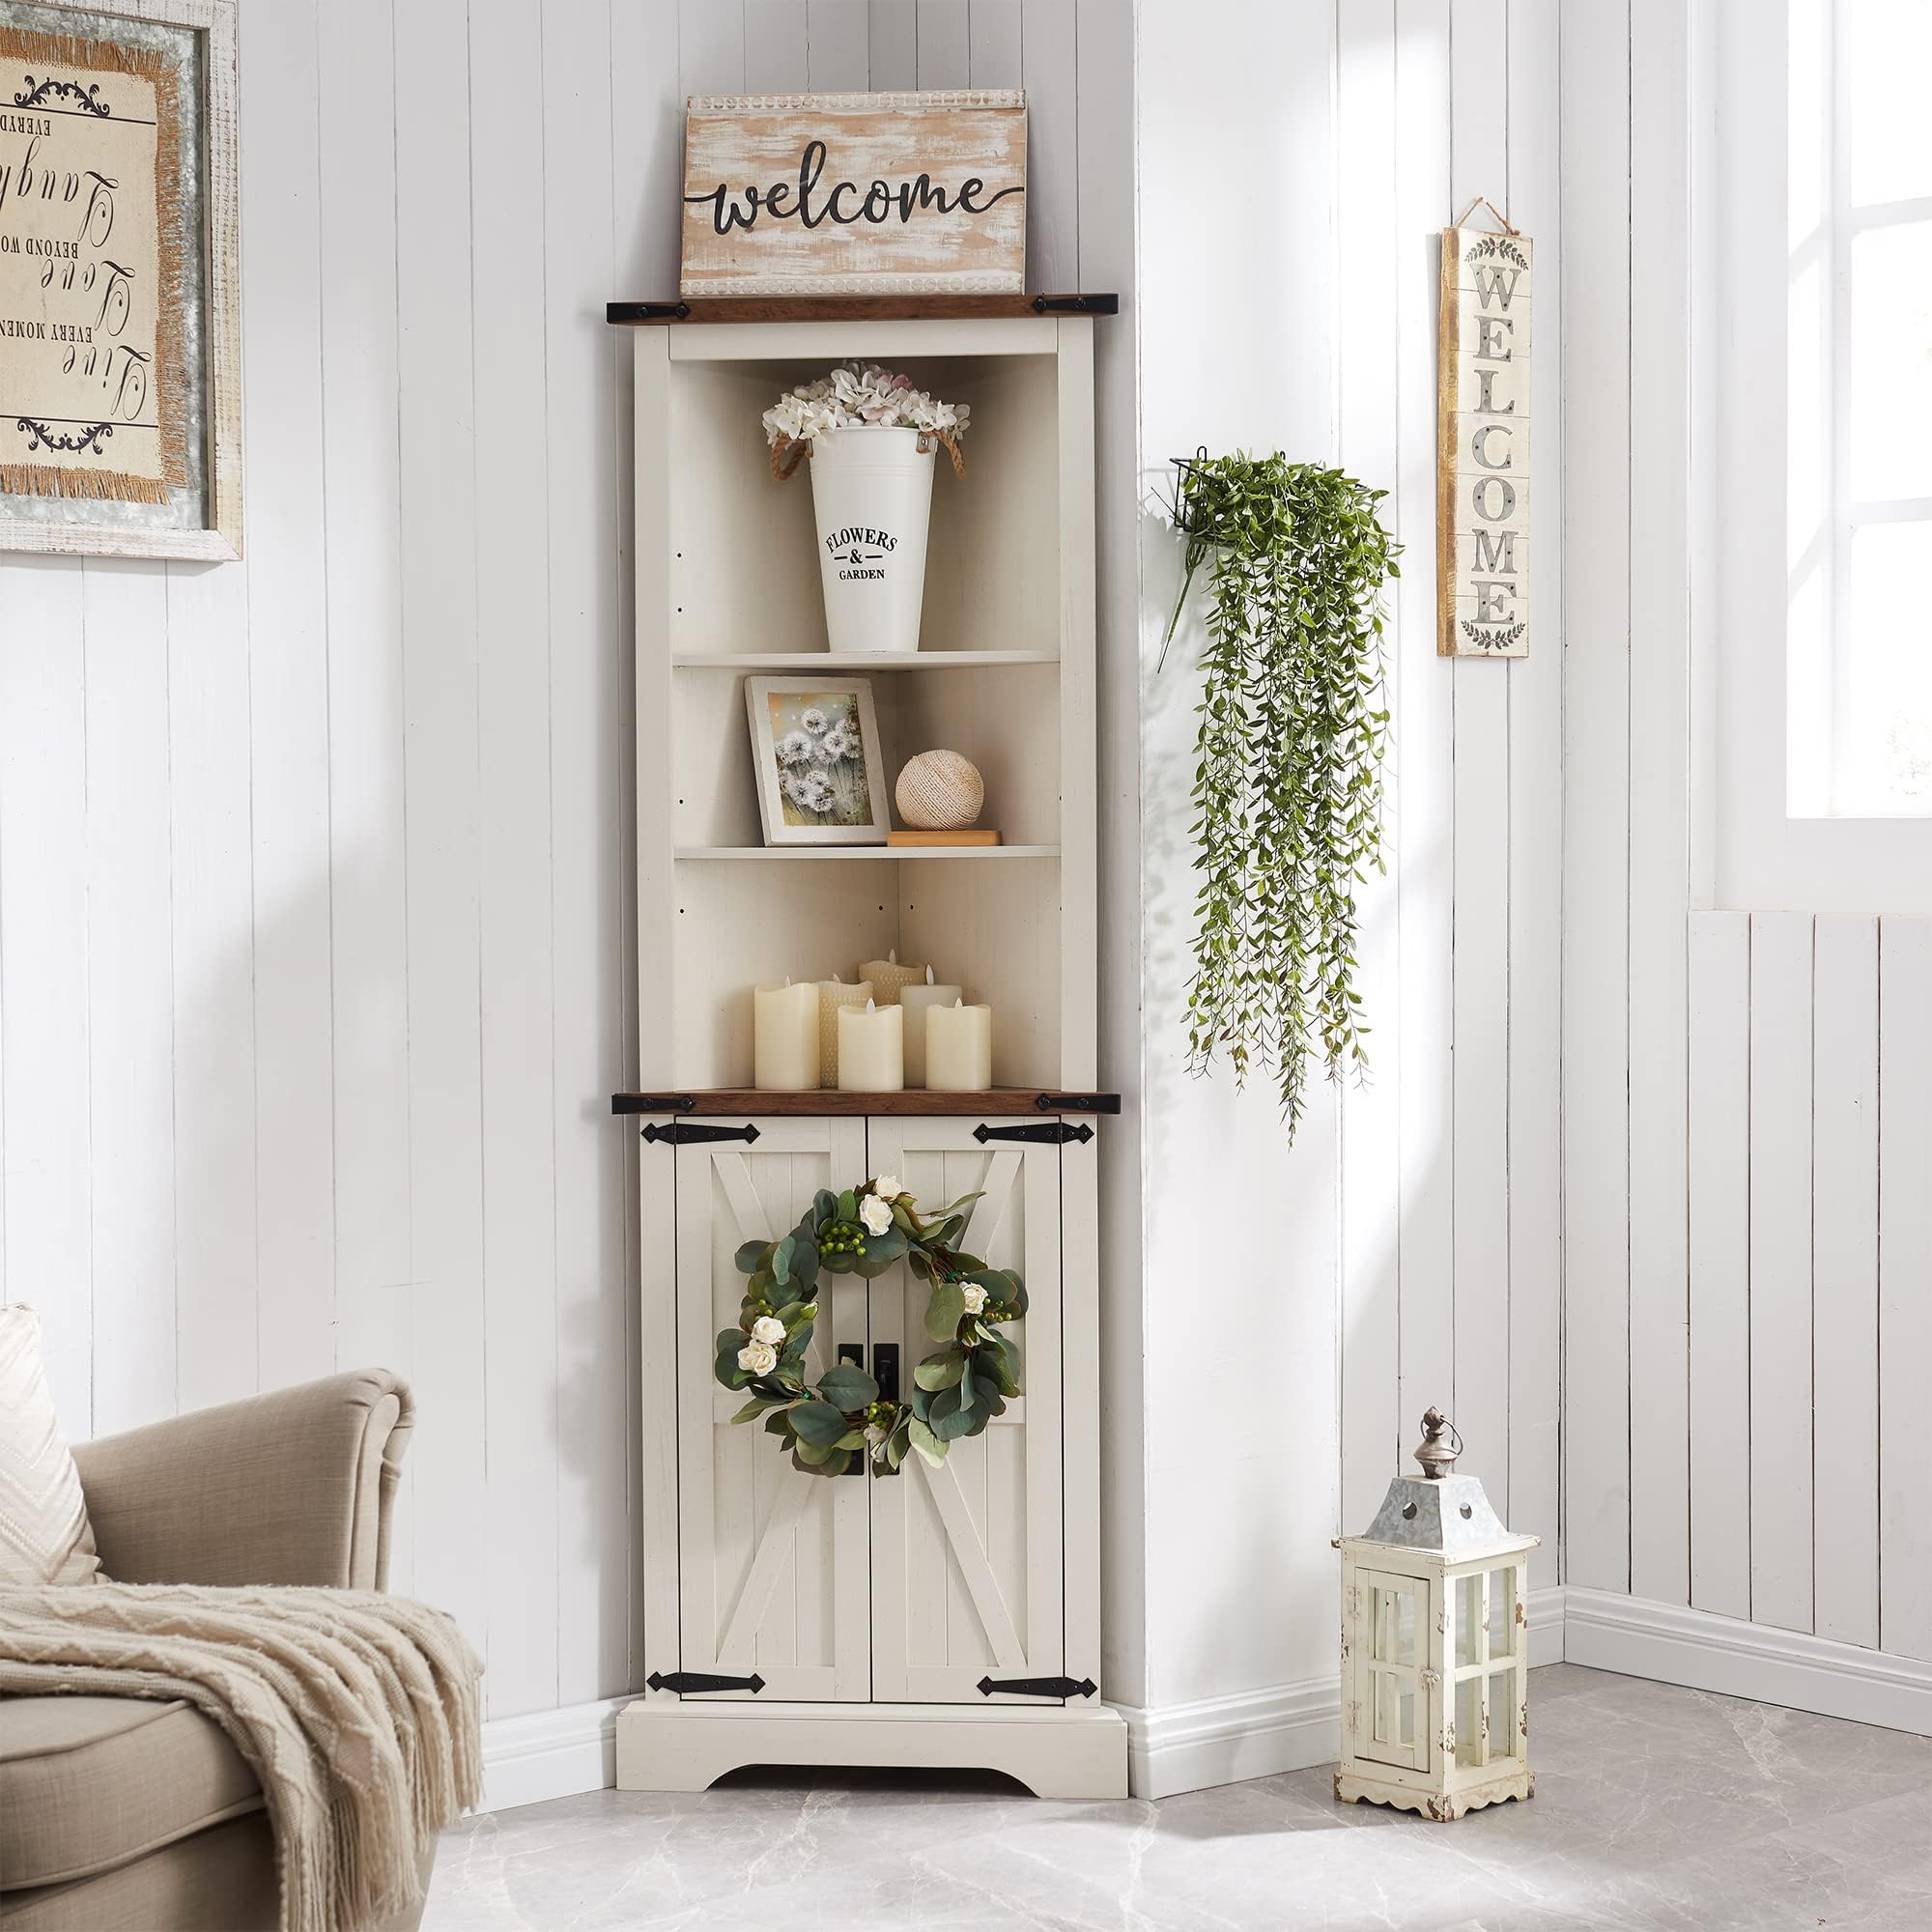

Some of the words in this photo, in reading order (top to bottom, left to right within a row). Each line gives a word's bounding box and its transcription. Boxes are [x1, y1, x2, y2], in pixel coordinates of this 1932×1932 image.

[0, 114, 51, 136] EVERYD
[684, 140, 1025, 235] welcome
[1, 235, 20, 253] WO
[26, 238, 78, 259] BEYOND
[41, 258, 136, 336] Love
[51, 324, 93, 343] EVERY
[63, 344, 152, 420] Live
[1469, 263, 1523, 626] WELCOME
[825, 526, 898, 554] FLOWERS
[849, 548, 863, 564] &
[838, 569, 885, 581] GARDEN
